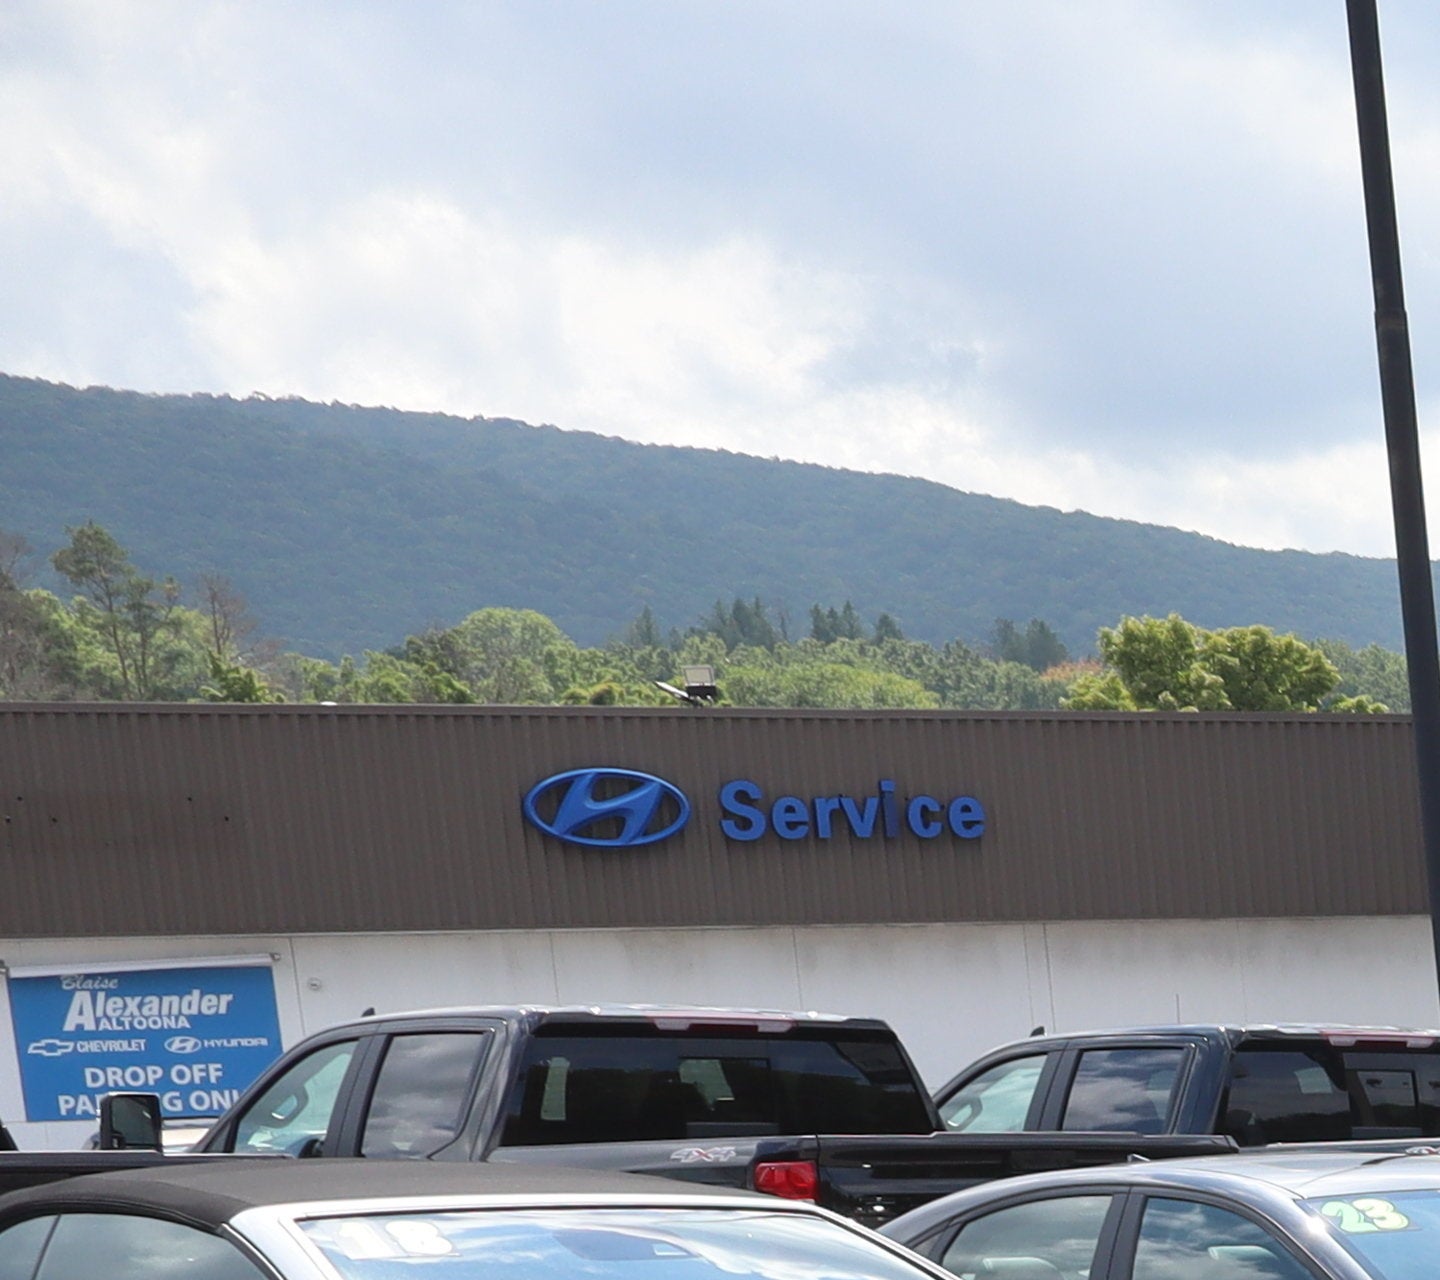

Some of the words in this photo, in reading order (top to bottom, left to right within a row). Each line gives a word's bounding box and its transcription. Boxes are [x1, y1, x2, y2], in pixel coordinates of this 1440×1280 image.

[719, 779, 987, 841] Service
[61, 974, 118, 990] Blaise
[62, 989, 234, 1032] Alexander
[98, 1014, 191, 1031] ALTOONA
[77, 1038, 147, 1053] CHEVROLET
[202, 1037, 268, 1048] HYUNDAI
[84, 1065, 163, 1088] DROP
[170, 1063, 224, 1085] OFF
[1321, 1198, 1409, 1233] 23
